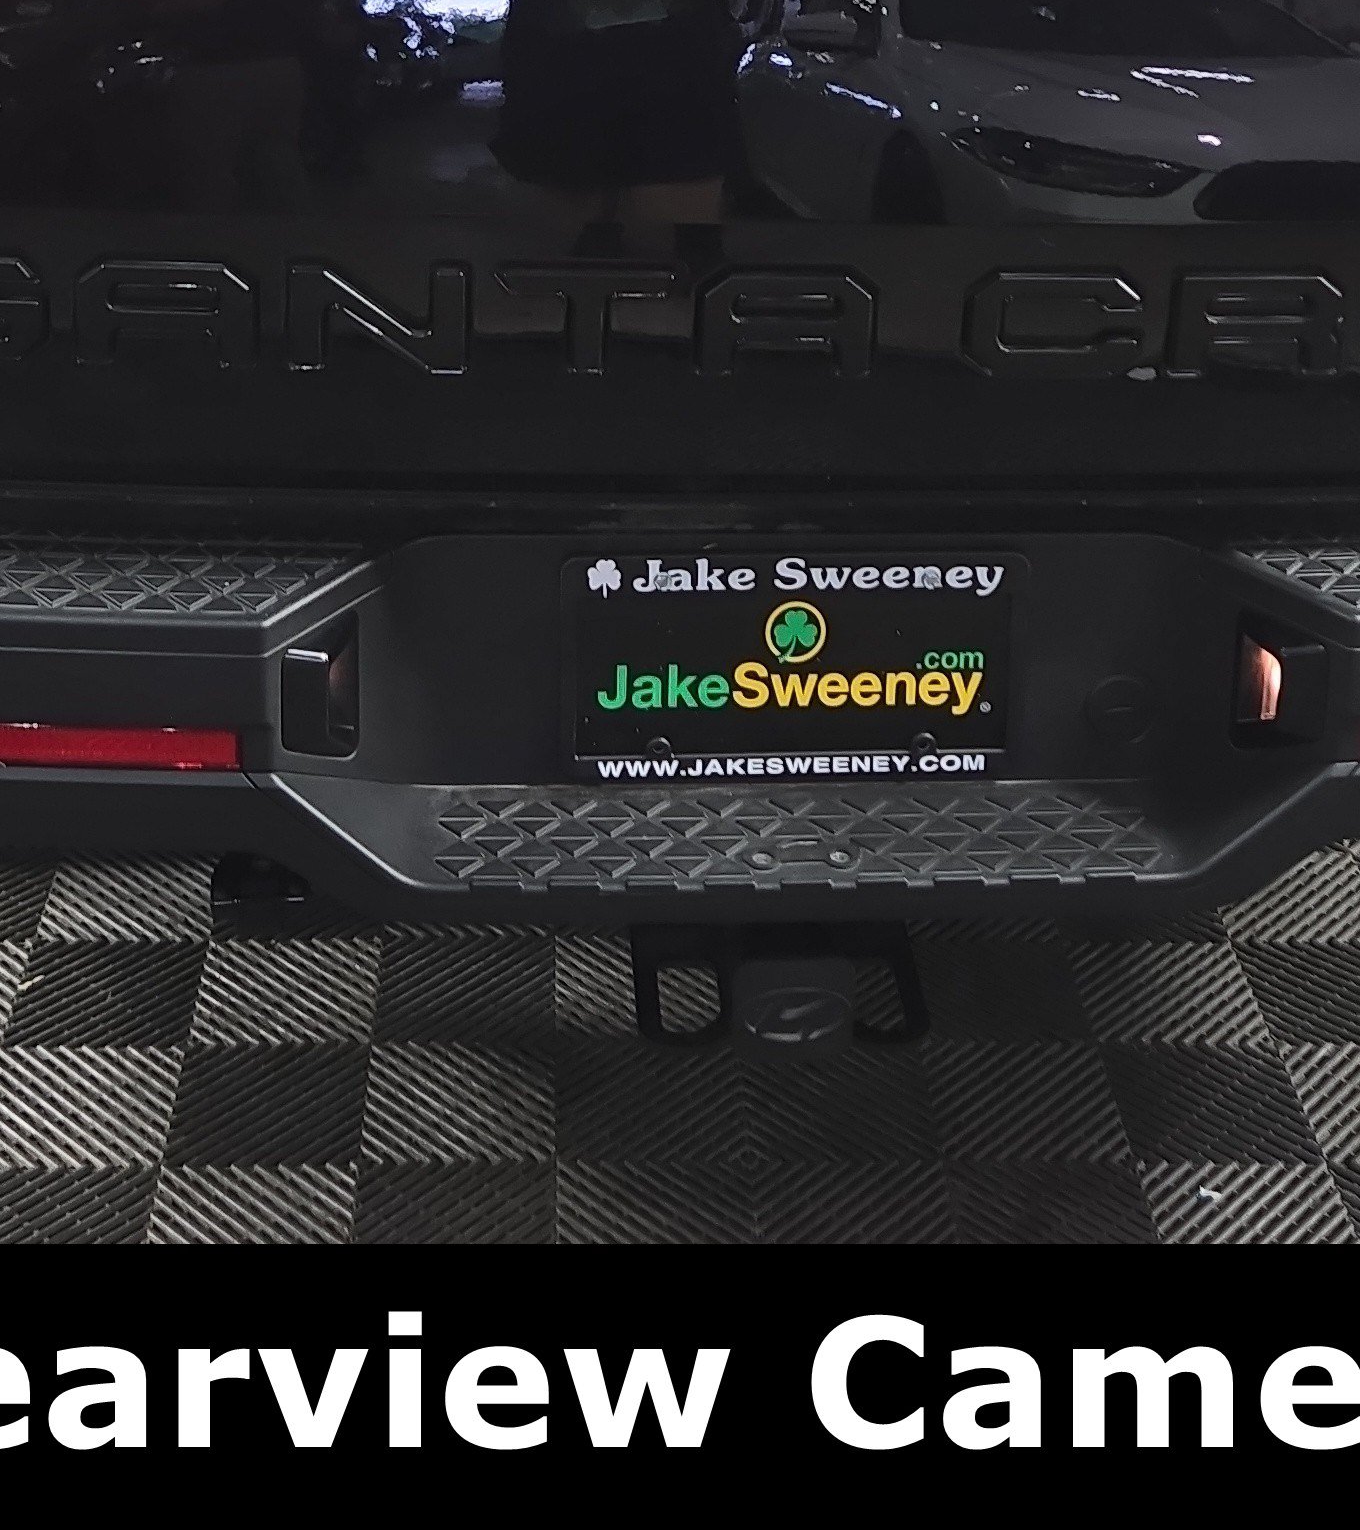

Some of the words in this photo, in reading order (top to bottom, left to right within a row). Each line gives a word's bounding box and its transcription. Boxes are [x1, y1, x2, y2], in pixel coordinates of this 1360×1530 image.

[633, 558, 756, 593] Jake
[773, 557, 1005, 597] Sweeney
[597, 754, 986, 779] WWW.JAKESWEENEY.COM
